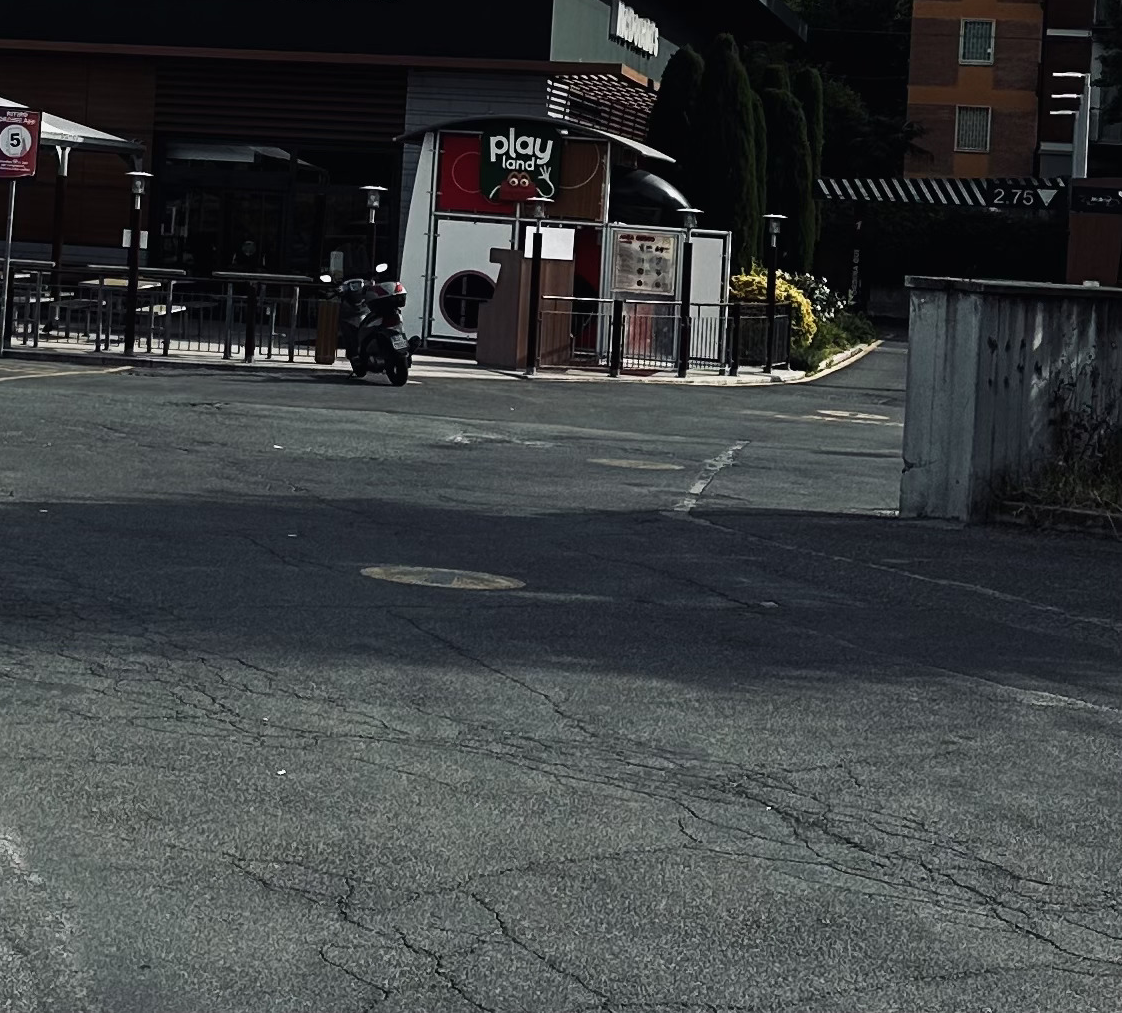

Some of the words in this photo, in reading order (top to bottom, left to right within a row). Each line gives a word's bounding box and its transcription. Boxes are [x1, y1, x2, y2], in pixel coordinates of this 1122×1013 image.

[10, 132, 21, 147] 5
[489, 127, 554, 165] play
[502, 156, 535, 171] land
[993, 189, 1034, 206] 2.75
